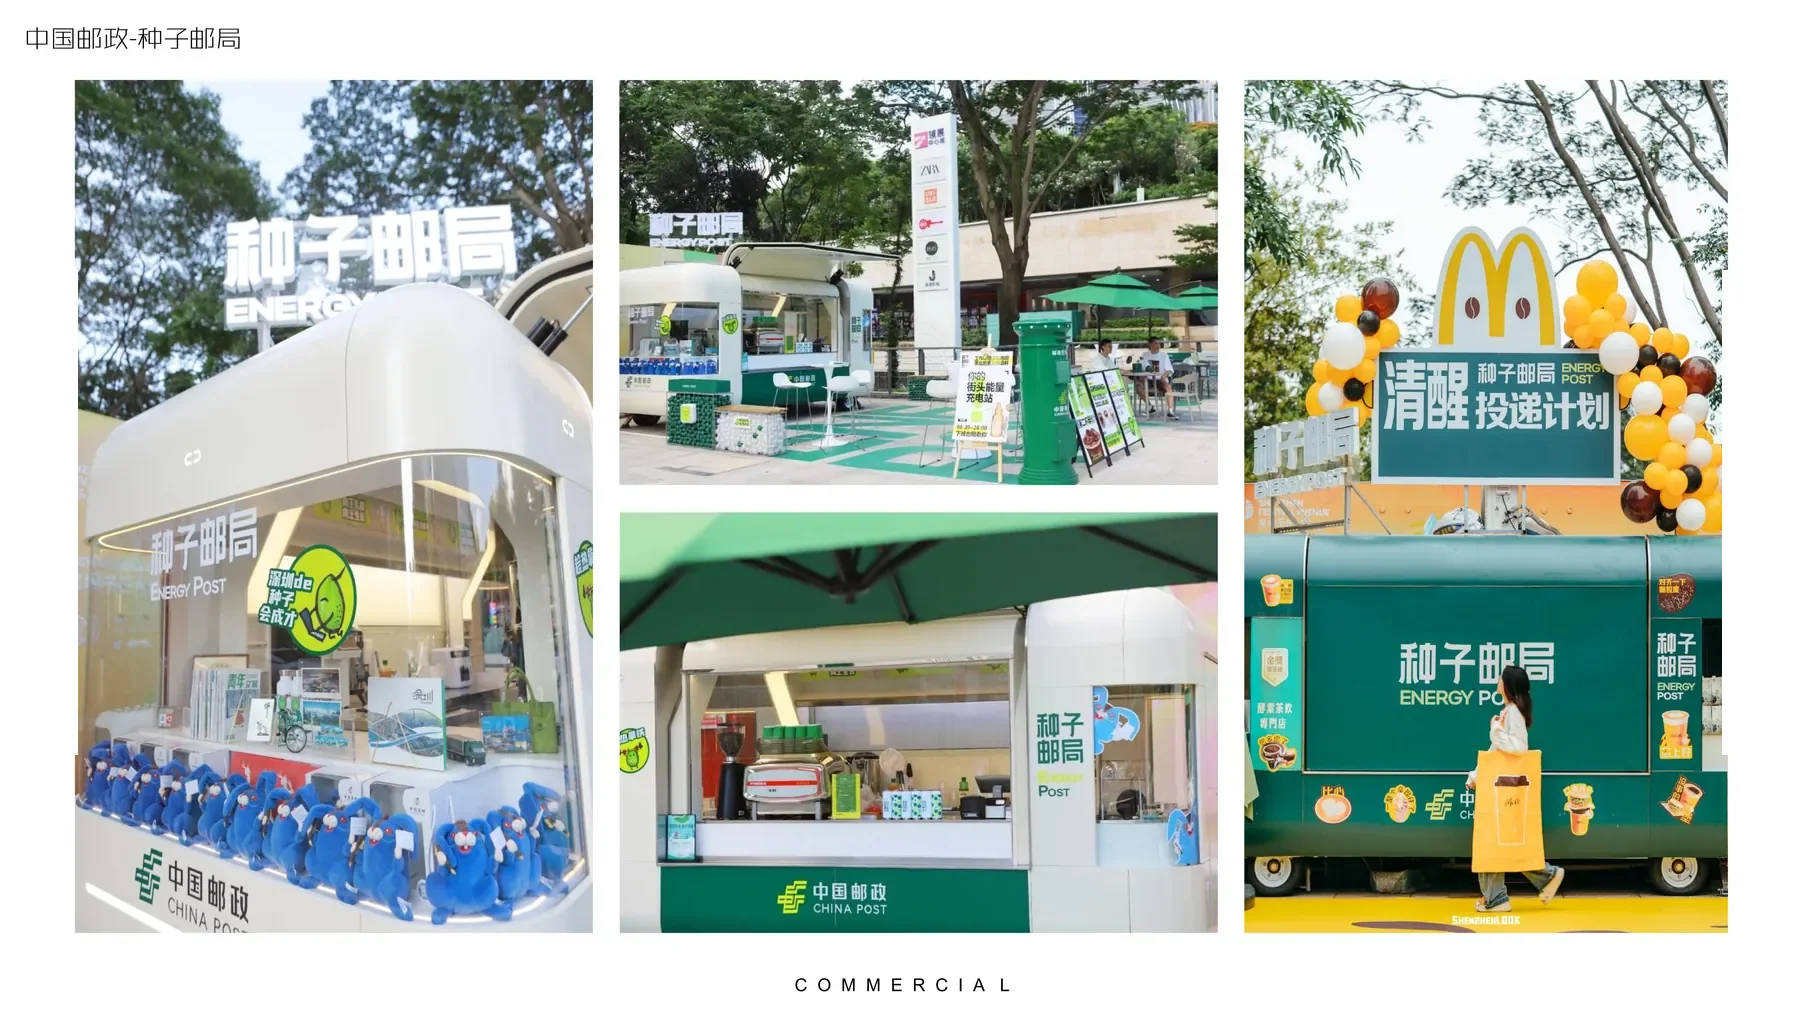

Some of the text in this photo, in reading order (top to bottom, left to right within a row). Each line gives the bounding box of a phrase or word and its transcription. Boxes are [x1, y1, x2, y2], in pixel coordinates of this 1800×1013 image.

[920, 164, 940, 176] ZARA
[648, 212, 743, 236] 种子邮局
[223, 204, 517, 293] 种子邮局
[967, 371, 986, 381] 你的
[1477, 362, 1556, 385] 种子邮局
[1561, 374, 1594, 385] POST
[966, 381, 1005, 393] 街头能量
[1384, 359, 1470, 431] 清醒
[966, 393, 993, 403] 充电站
[1475, 391, 1610, 431] 投递计划
[1253, 407, 1360, 476] 种子邮局
[151, 507, 258, 576] 种子邮局
[193, 576, 227, 597] POST
[268, 570, 313, 590] 深圳de
[268, 589, 295, 607] 种子
[259, 604, 297, 628] 会成才
[1656, 632, 1697, 654] 种子
[1398, 642, 1555, 685] 种子邮局
[1656, 655, 1697, 678] 邮局
[227, 673, 246, 689] 青年
[1656, 682, 1696, 691] ENERGY
[1400, 690, 1506, 706] ENERGY PO
[1656, 692, 1684, 701] POST
[1037, 712, 1084, 738] 种子
[1260, 718, 1287, 729] 專門店
[1037, 739, 1084, 764] 邮局
[1038, 785, 1070, 797] POST
[168, 860, 249, 924] 中国邮政
[813, 882, 886, 901] 中国邮政
[168, 897, 249, 933] CHINA PO
[813, 903, 887, 914] CHINA POST
